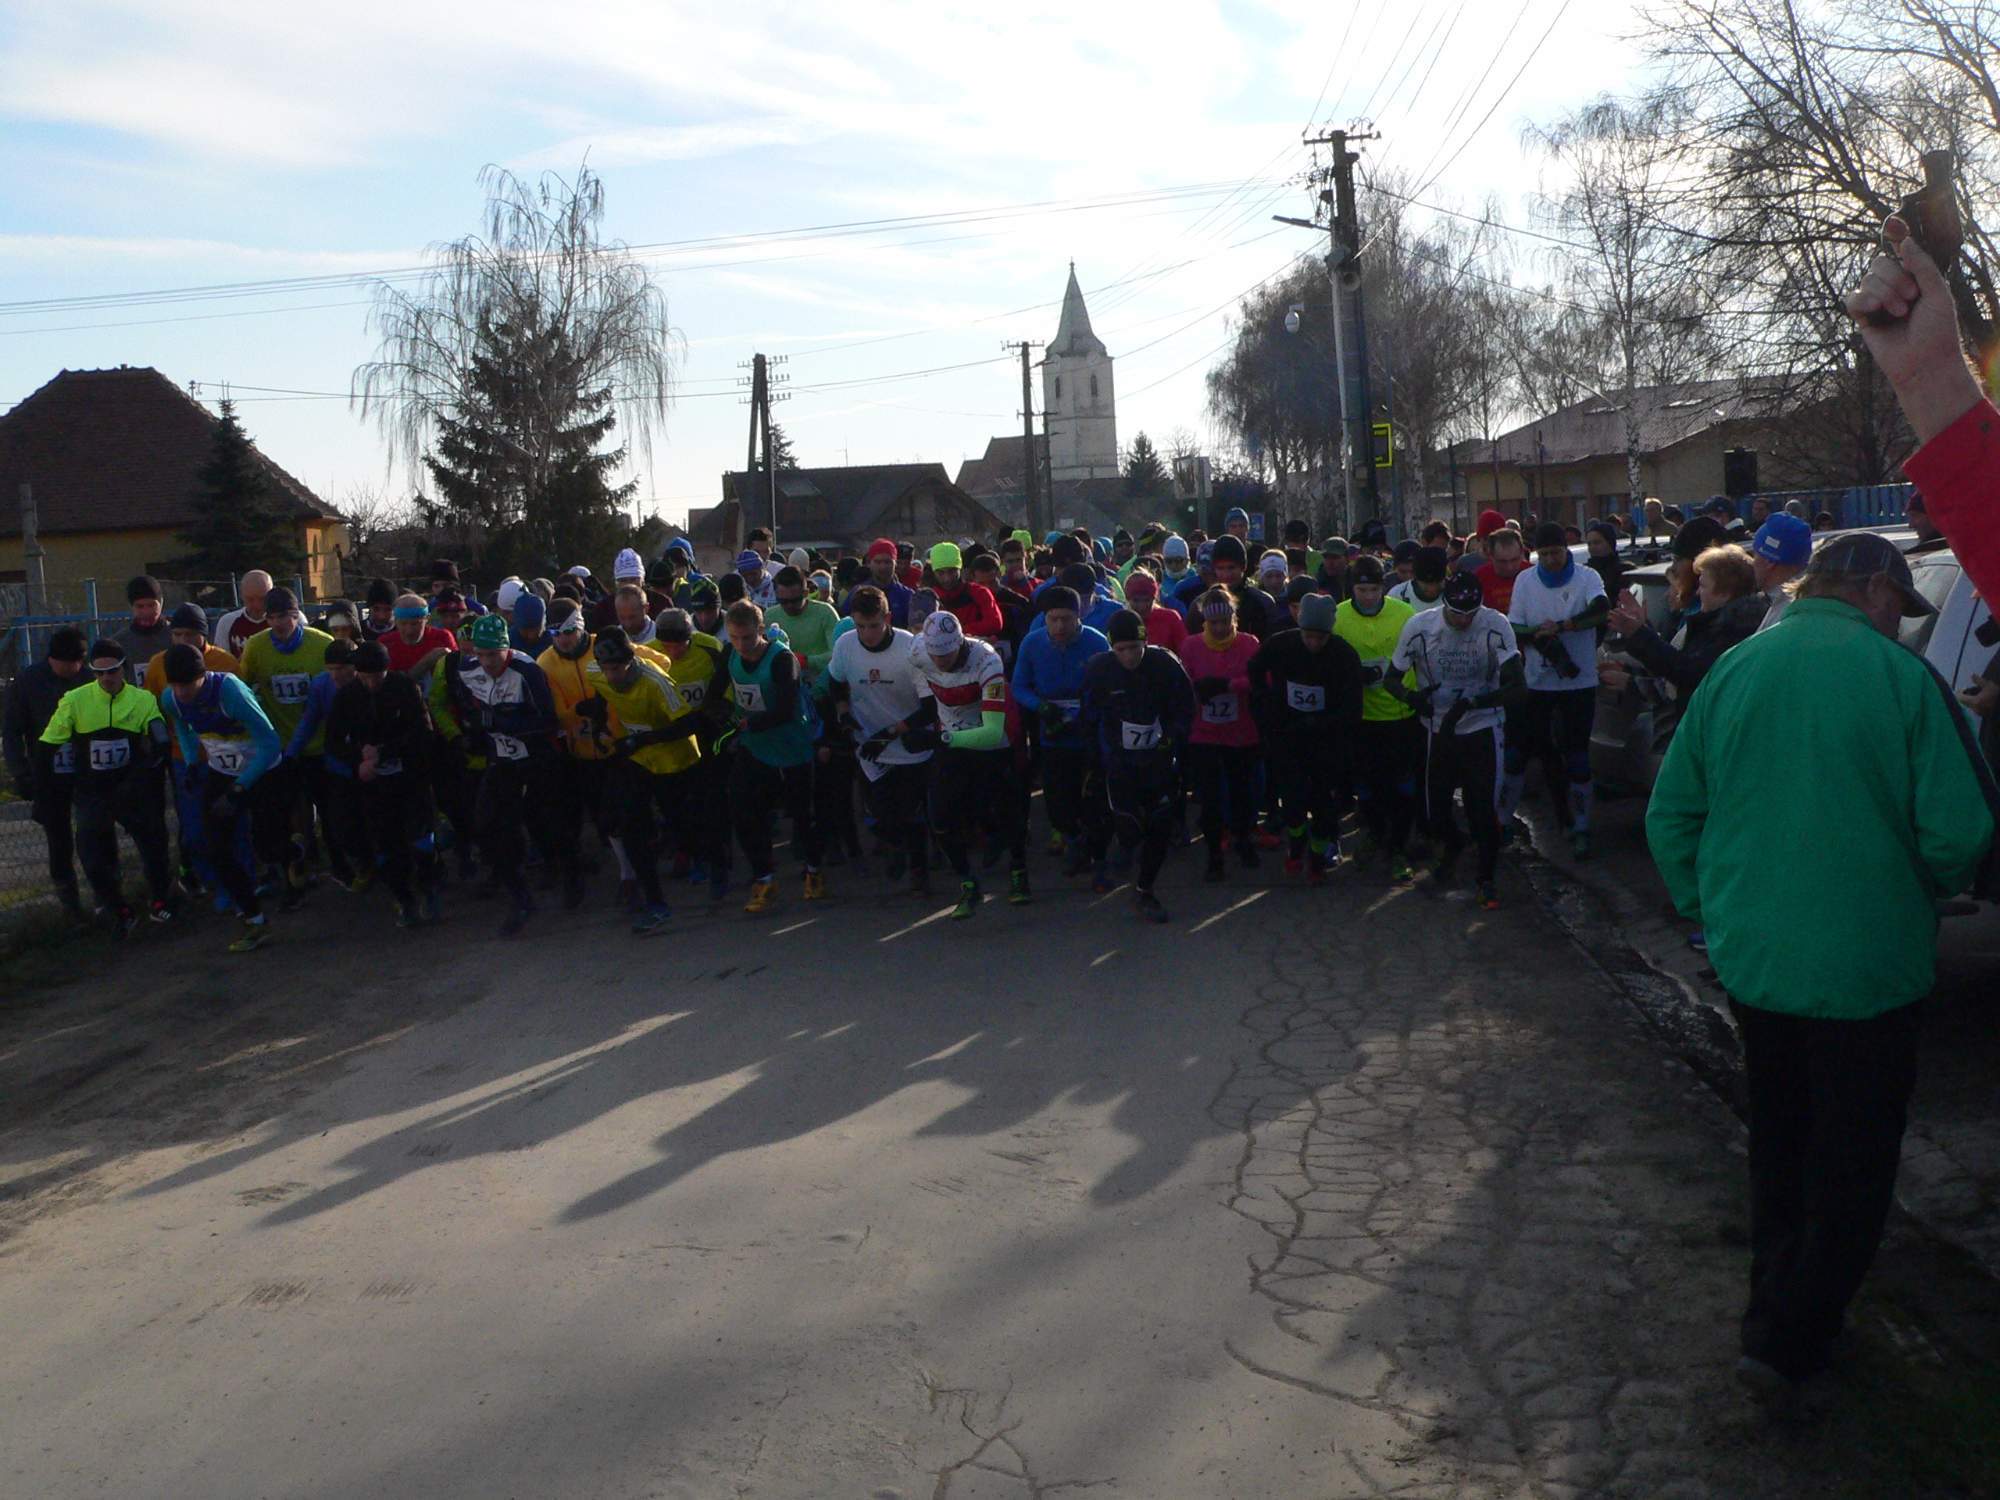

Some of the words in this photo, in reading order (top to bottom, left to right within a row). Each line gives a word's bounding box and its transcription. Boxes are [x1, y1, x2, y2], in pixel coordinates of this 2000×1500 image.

[1294, 690, 1318, 705] 54
[93, 748, 128, 764] 117
[216, 754, 237, 768] 17
